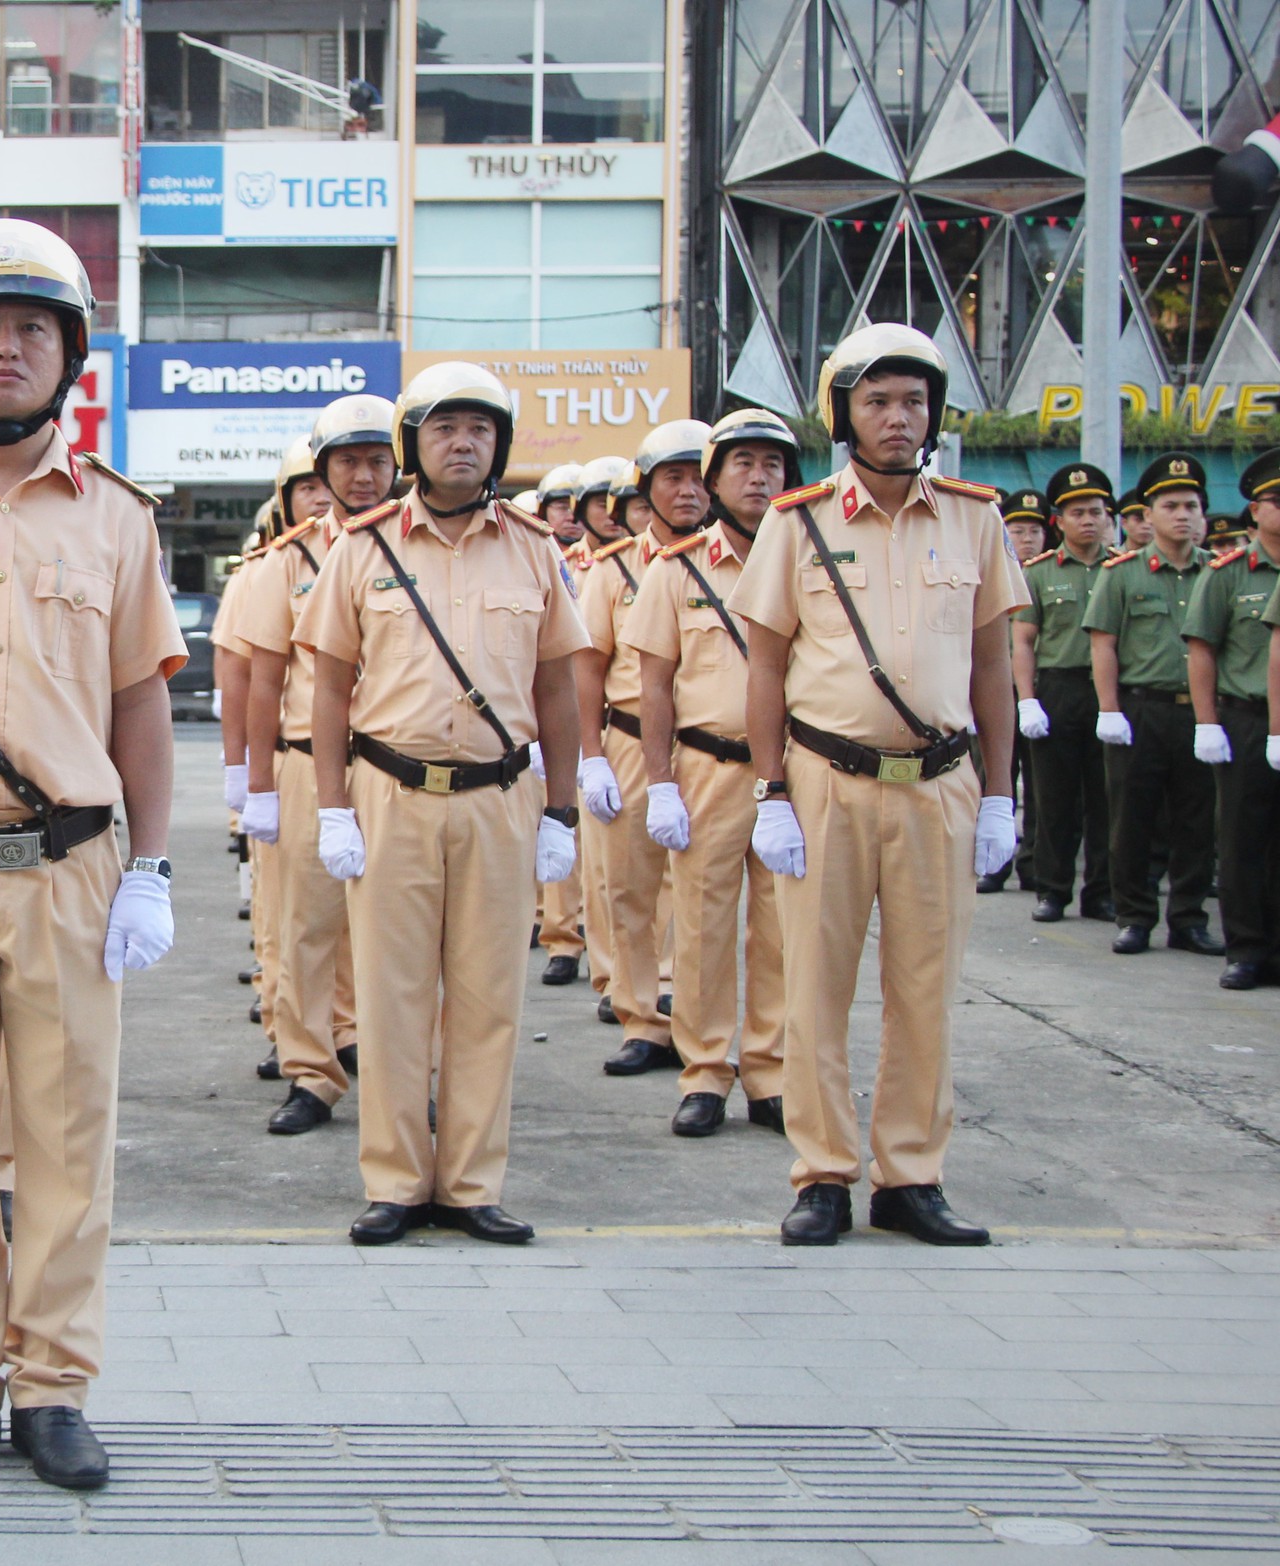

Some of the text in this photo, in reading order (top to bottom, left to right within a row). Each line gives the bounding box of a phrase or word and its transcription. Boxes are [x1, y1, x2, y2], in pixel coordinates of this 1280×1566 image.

[468, 149, 617, 177] THU THỦY
[280, 178, 388, 207] TIGER
[161, 358, 367, 394] Panasonic
[493, 361, 511, 374] TY
[516, 361, 557, 375] TNHH
[536, 377, 670, 425] THỦY
[178, 448, 214, 463] ĐIỆN
